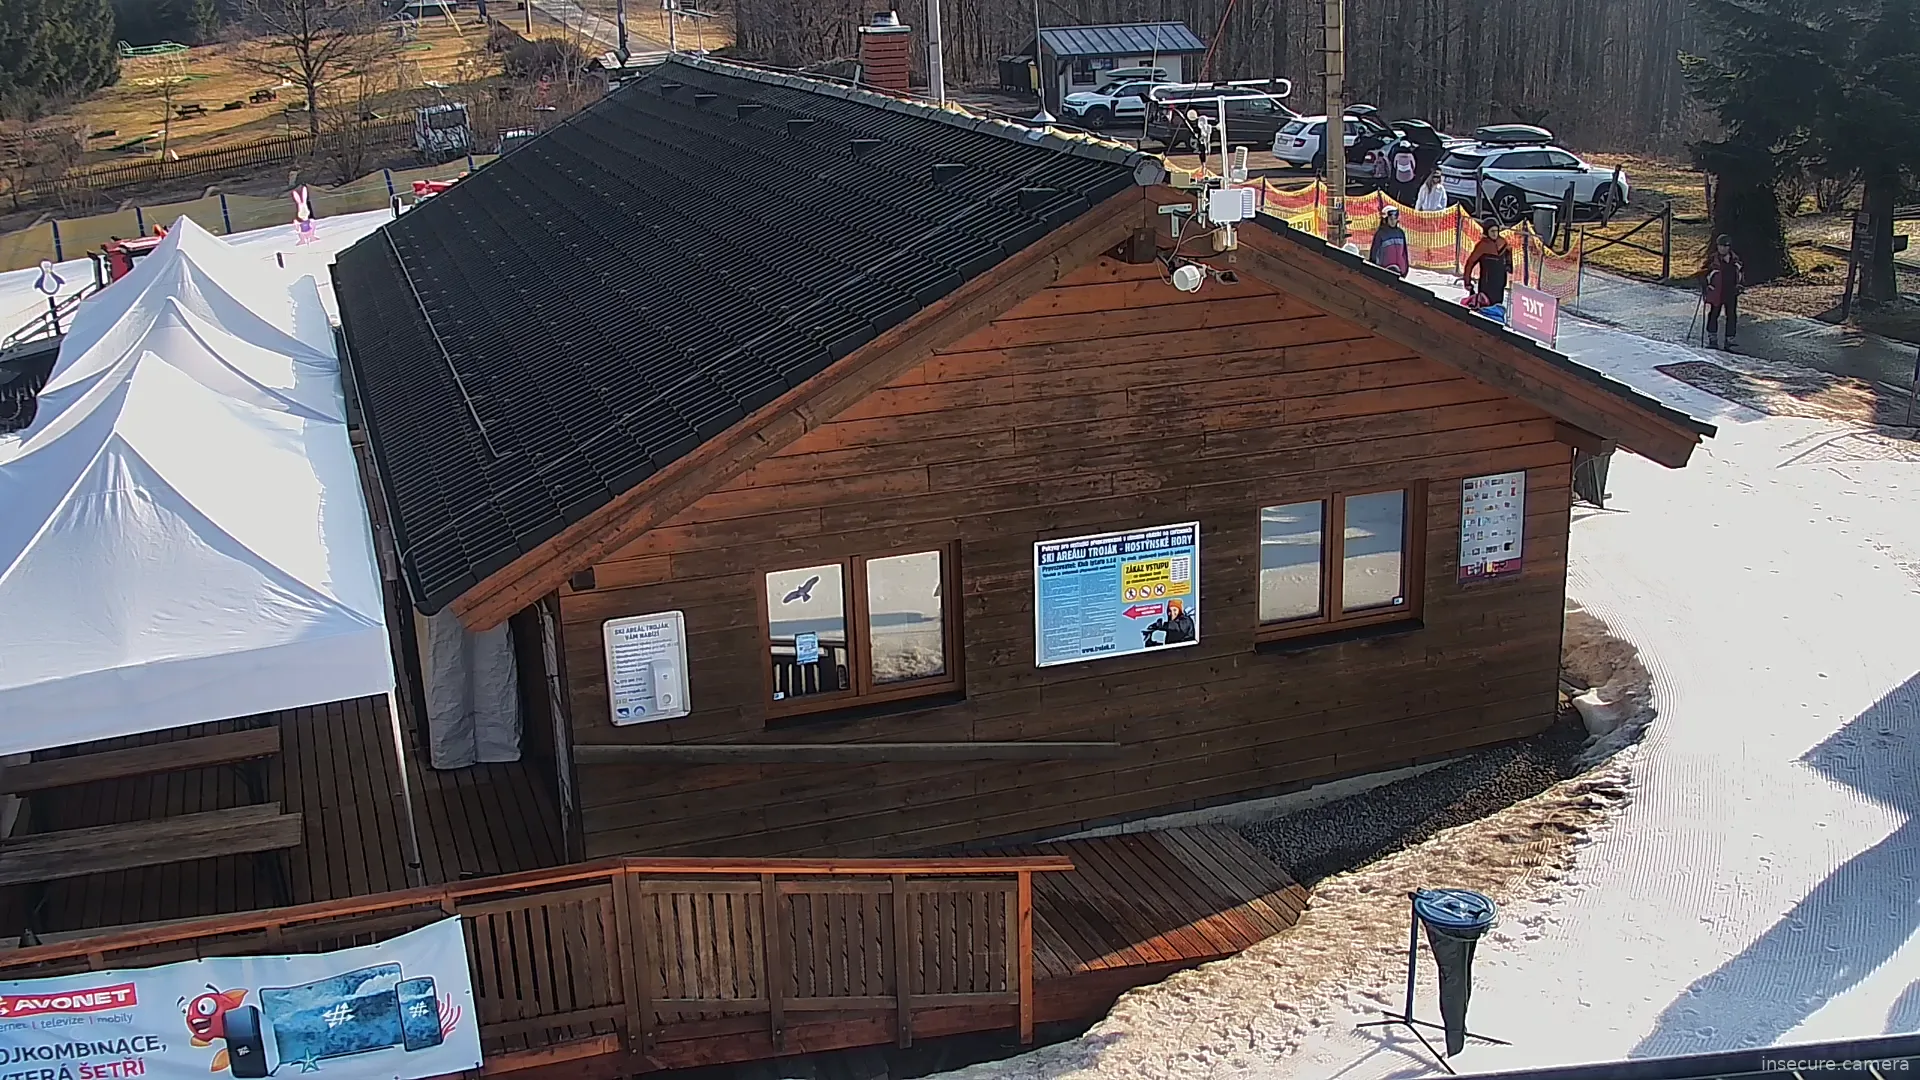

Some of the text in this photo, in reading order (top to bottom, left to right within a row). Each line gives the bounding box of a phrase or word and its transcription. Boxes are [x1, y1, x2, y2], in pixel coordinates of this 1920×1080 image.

[1041, 552, 1055, 564] SKI
[1056, 547, 1087, 561] AREÁLU
[1125, 536, 1169, 552] HOSTÝNSKÉ
[1171, 534, 1193, 546] HORY
[1125, 564, 1145, 574] ZÁKAZ
[1145, 561, 1169, 571] VSTUPU
[14, 988, 131, 1012] AVONET
[40, 1016, 85, 1029] televize
[97, 1013, 134, 1025] mobily
[79, 1057, 146, 1080] ŠETŘÍ
